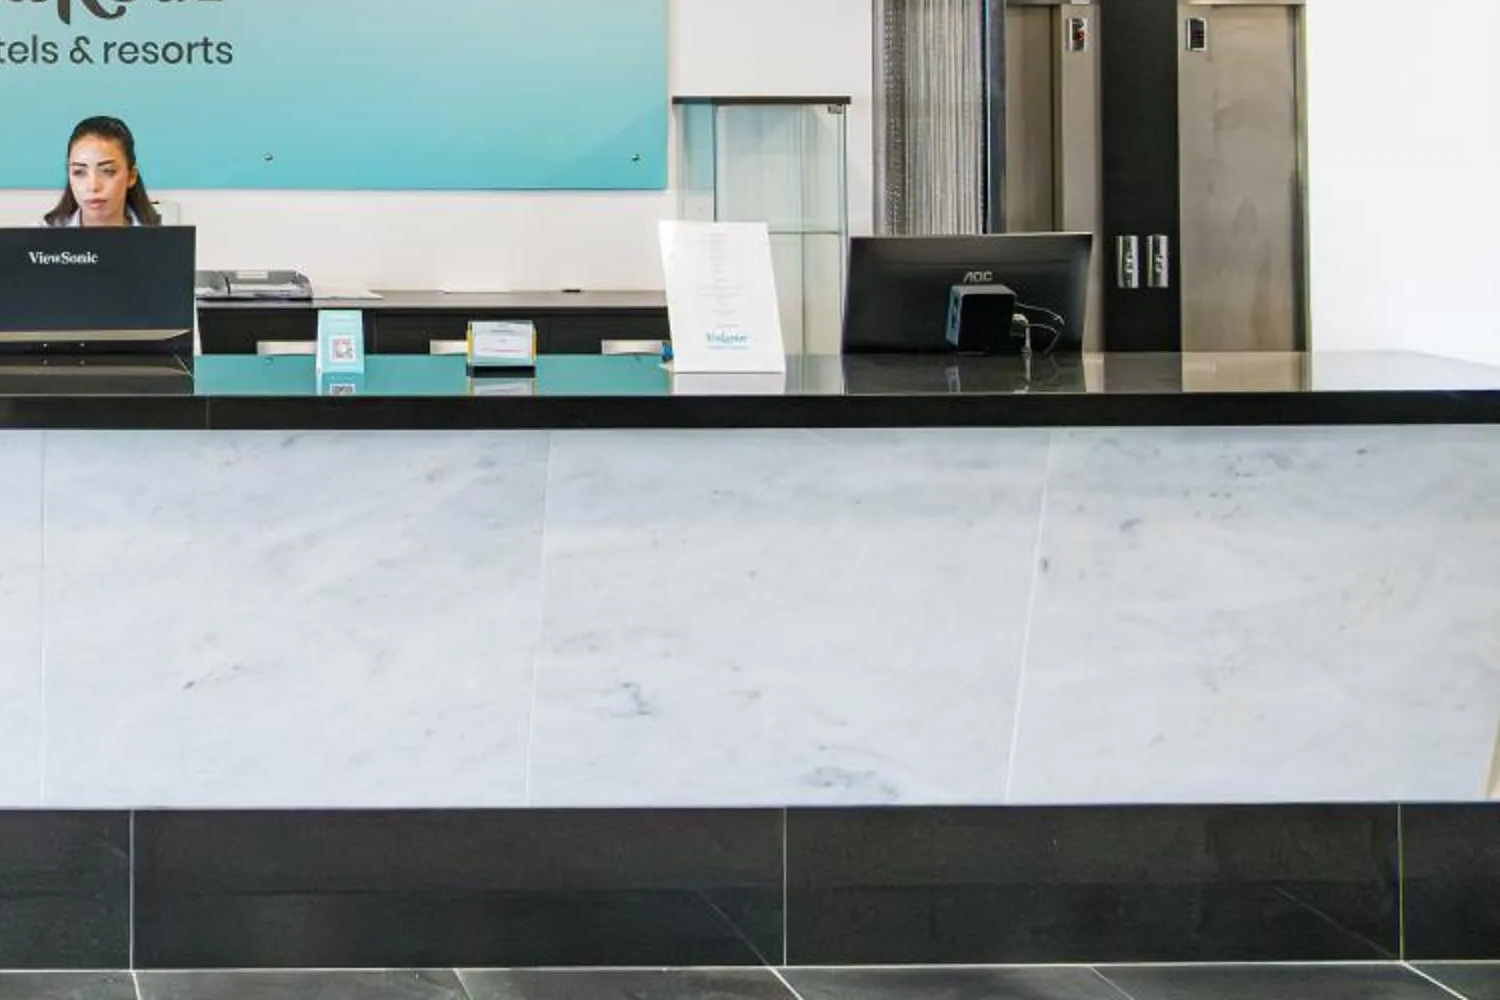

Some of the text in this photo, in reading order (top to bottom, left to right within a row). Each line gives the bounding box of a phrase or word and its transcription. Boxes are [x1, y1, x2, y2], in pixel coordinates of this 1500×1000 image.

[69, 35, 94, 64] &
[103, 36, 234, 64] resorts
[27, 250, 99, 265] ViewSonic
